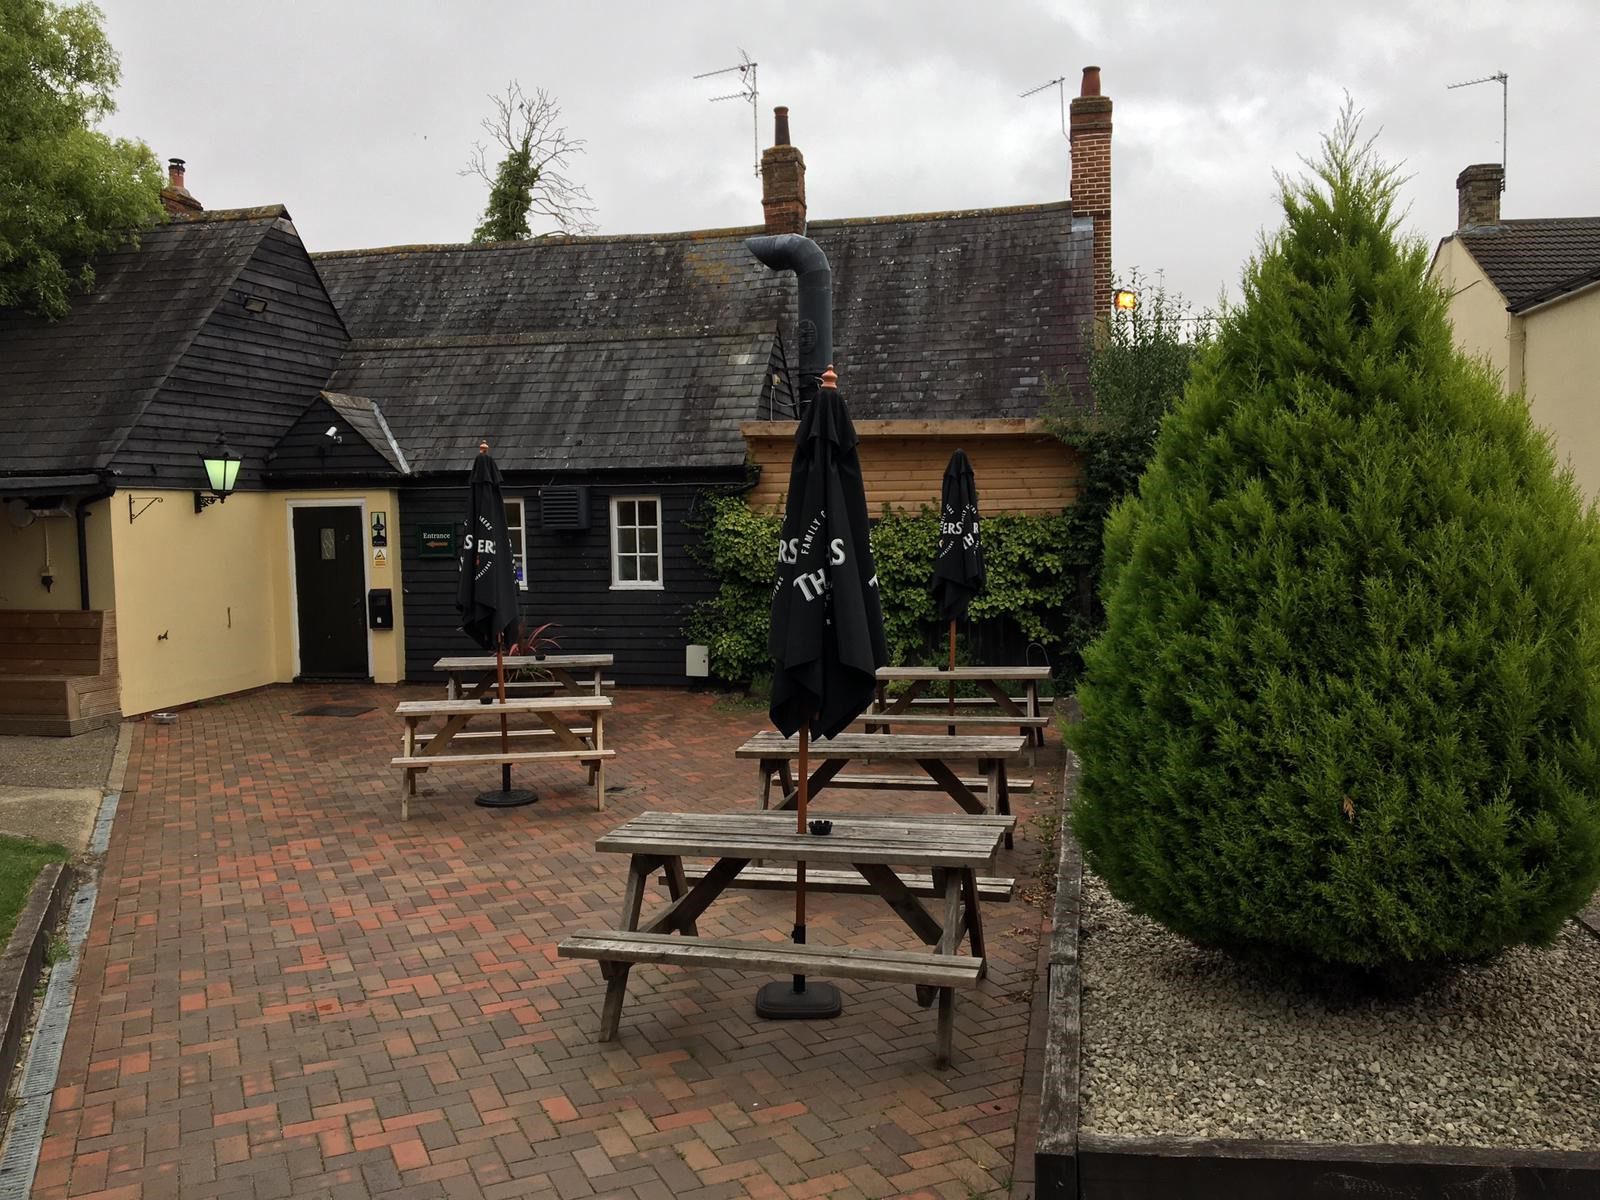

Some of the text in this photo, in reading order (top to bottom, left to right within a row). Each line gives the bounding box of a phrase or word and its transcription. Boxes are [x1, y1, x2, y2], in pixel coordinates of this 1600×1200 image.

[423, 532, 451, 540] Entrance
[801, 518, 821, 555] FAMILY
[943, 521, 963, 535] ERS
[793, 568, 826, 602] TH
